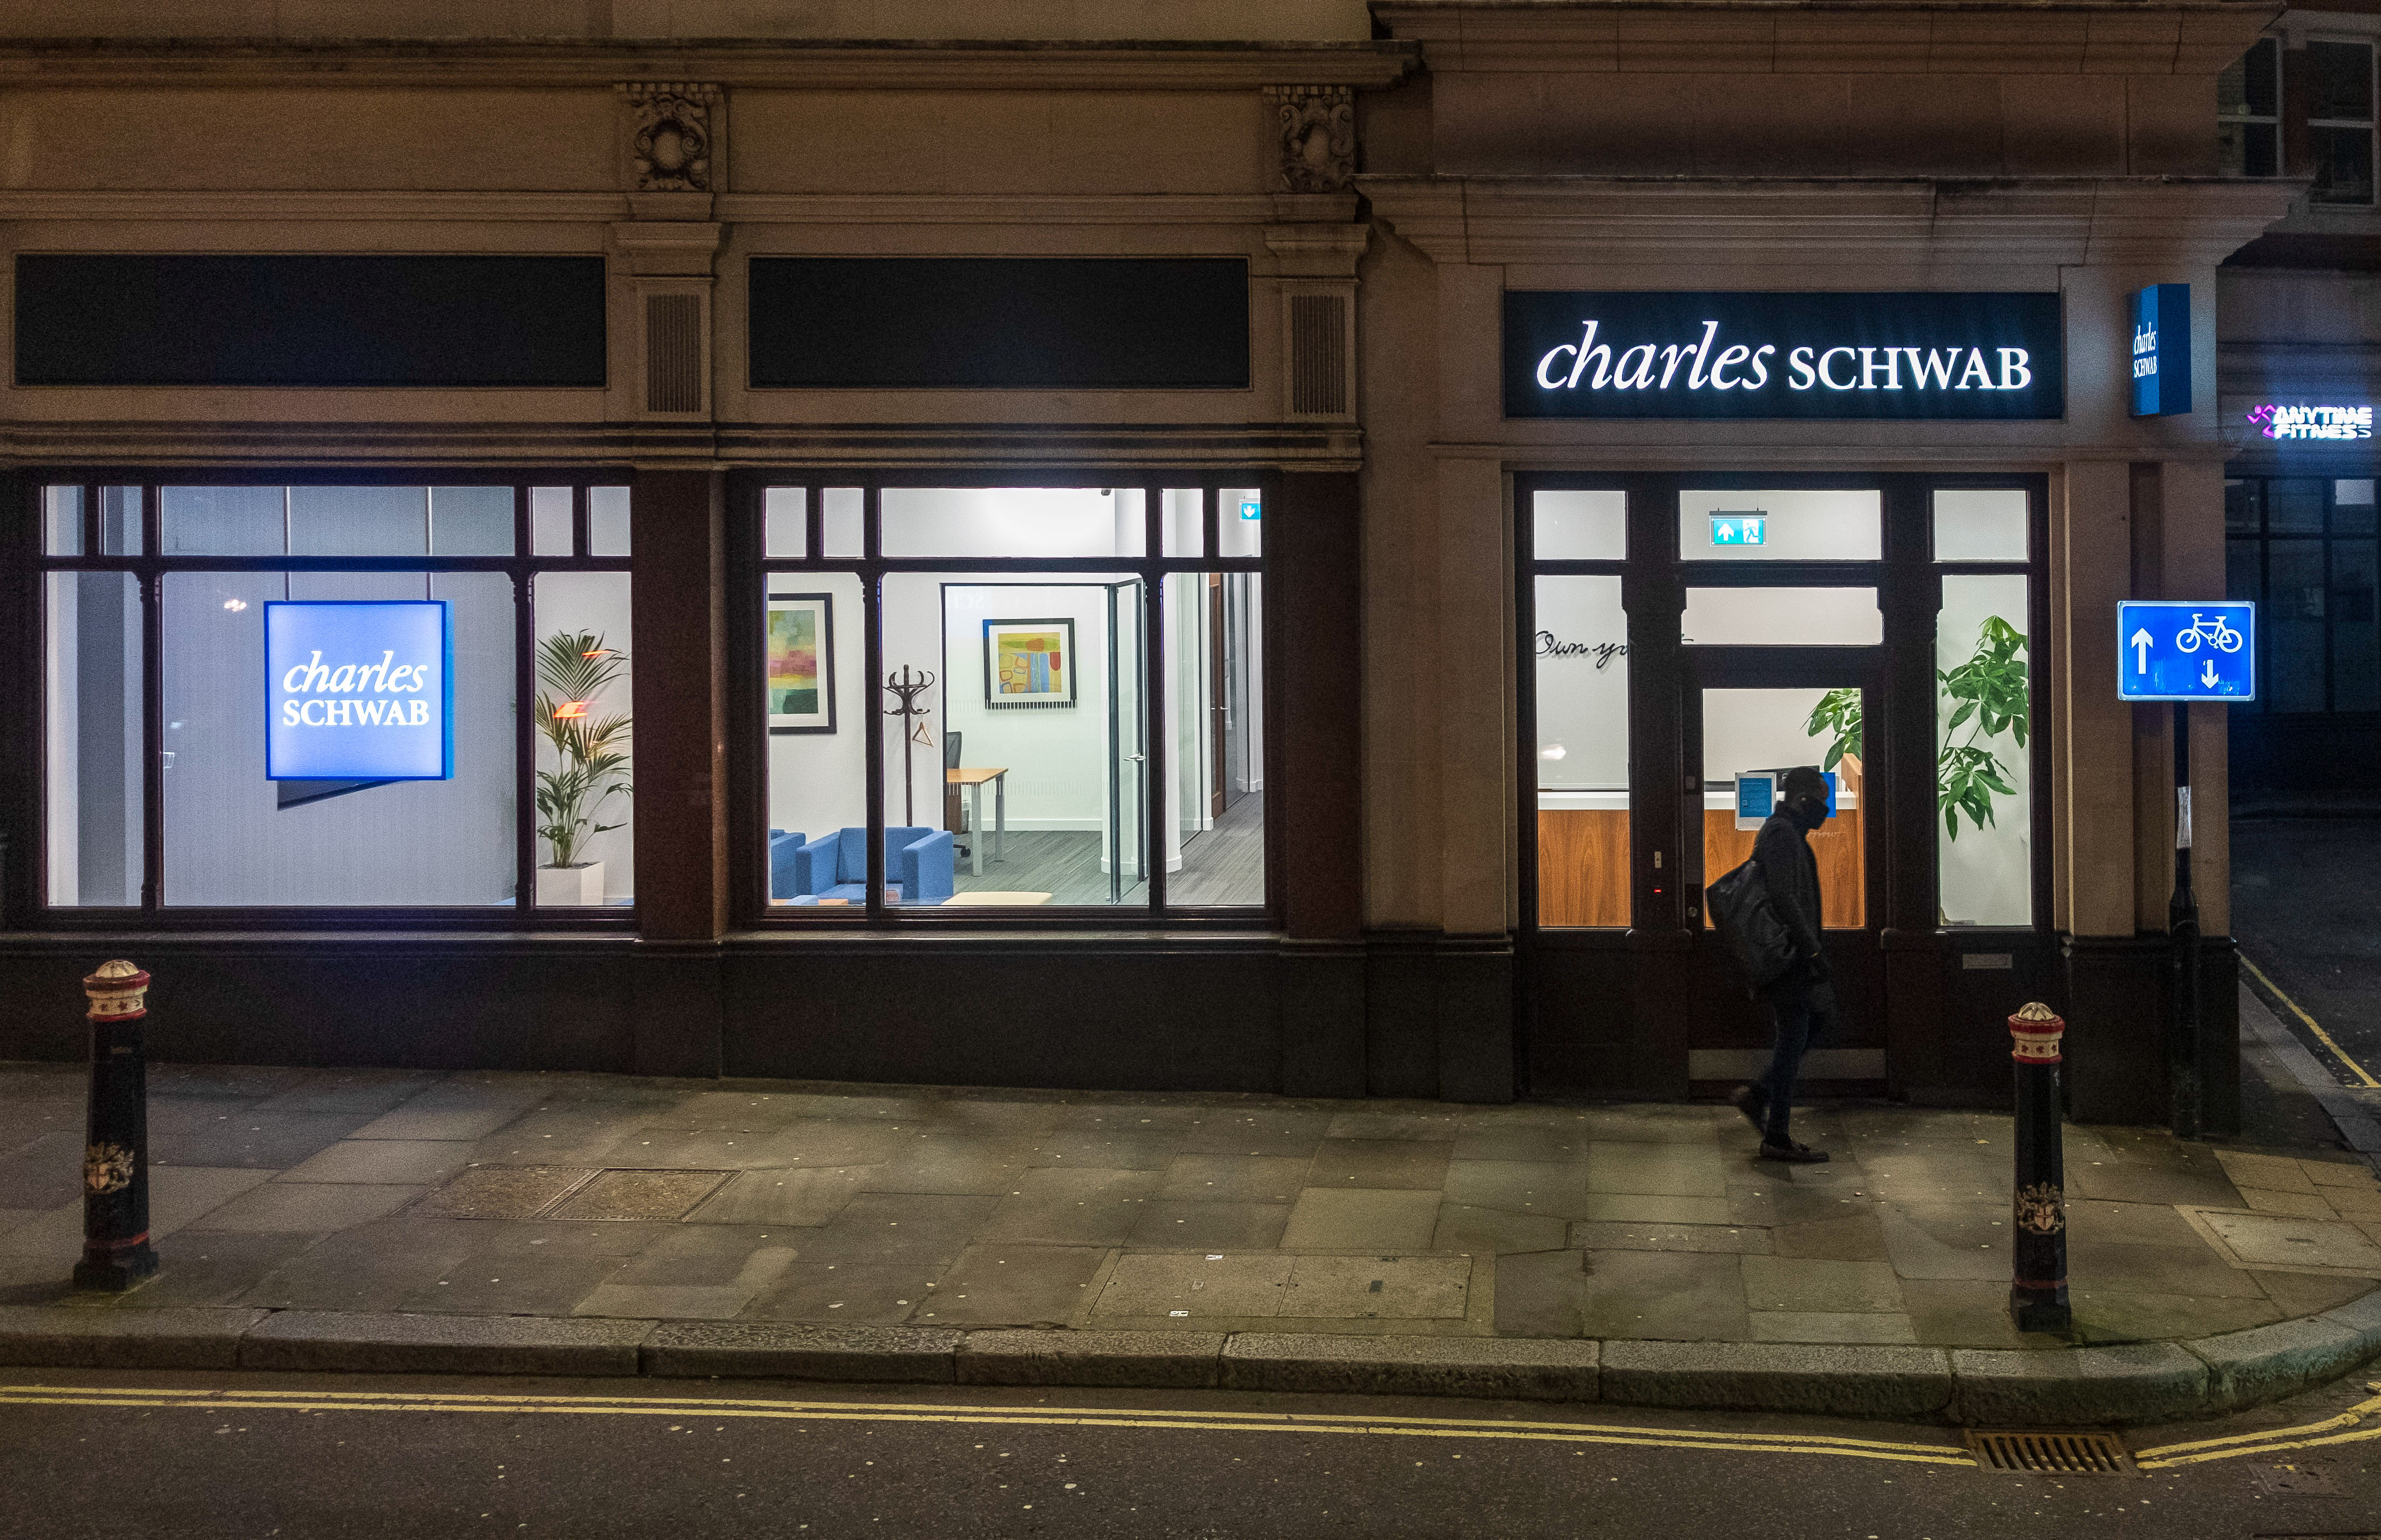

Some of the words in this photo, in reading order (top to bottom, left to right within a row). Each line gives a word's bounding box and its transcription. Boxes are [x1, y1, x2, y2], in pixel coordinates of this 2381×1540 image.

[2134, 322, 2156, 355] charles
[1536, 320, 1775, 390] charles
[1788, 347, 2031, 390] SCHWAB
[2134, 356, 2157, 378] SCHWAB
[2273, 406, 2372, 424] ANYTIME
[2274, 424, 2372, 440] FITNESS
[1536, 630, 1588, 655] Own
[283, 650, 428, 693] charles
[283, 699, 430, 726] SCHWAB
